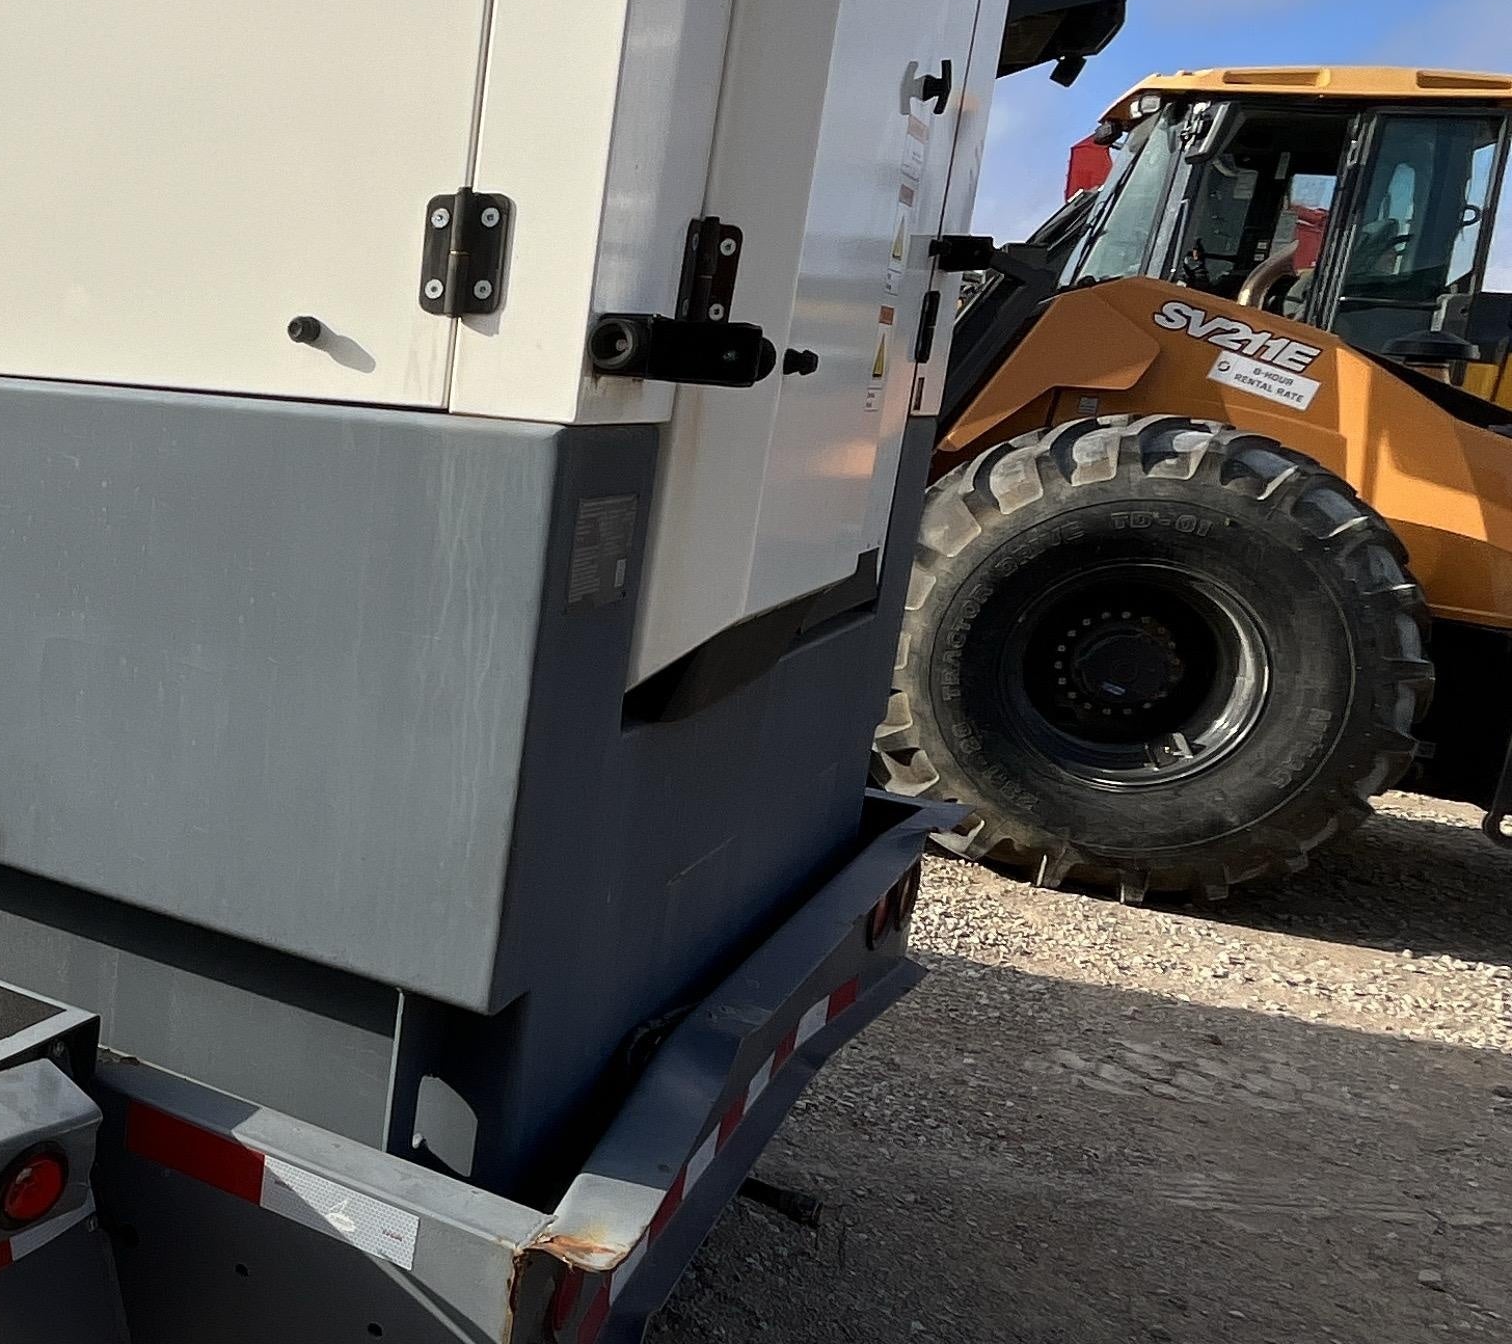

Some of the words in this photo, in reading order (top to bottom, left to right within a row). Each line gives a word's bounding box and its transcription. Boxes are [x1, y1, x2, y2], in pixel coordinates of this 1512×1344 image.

[1153, 300, 1325, 377] SV211E
[1233, 372, 1273, 394] RENTAL
[1276, 386, 1305, 404] RATE
